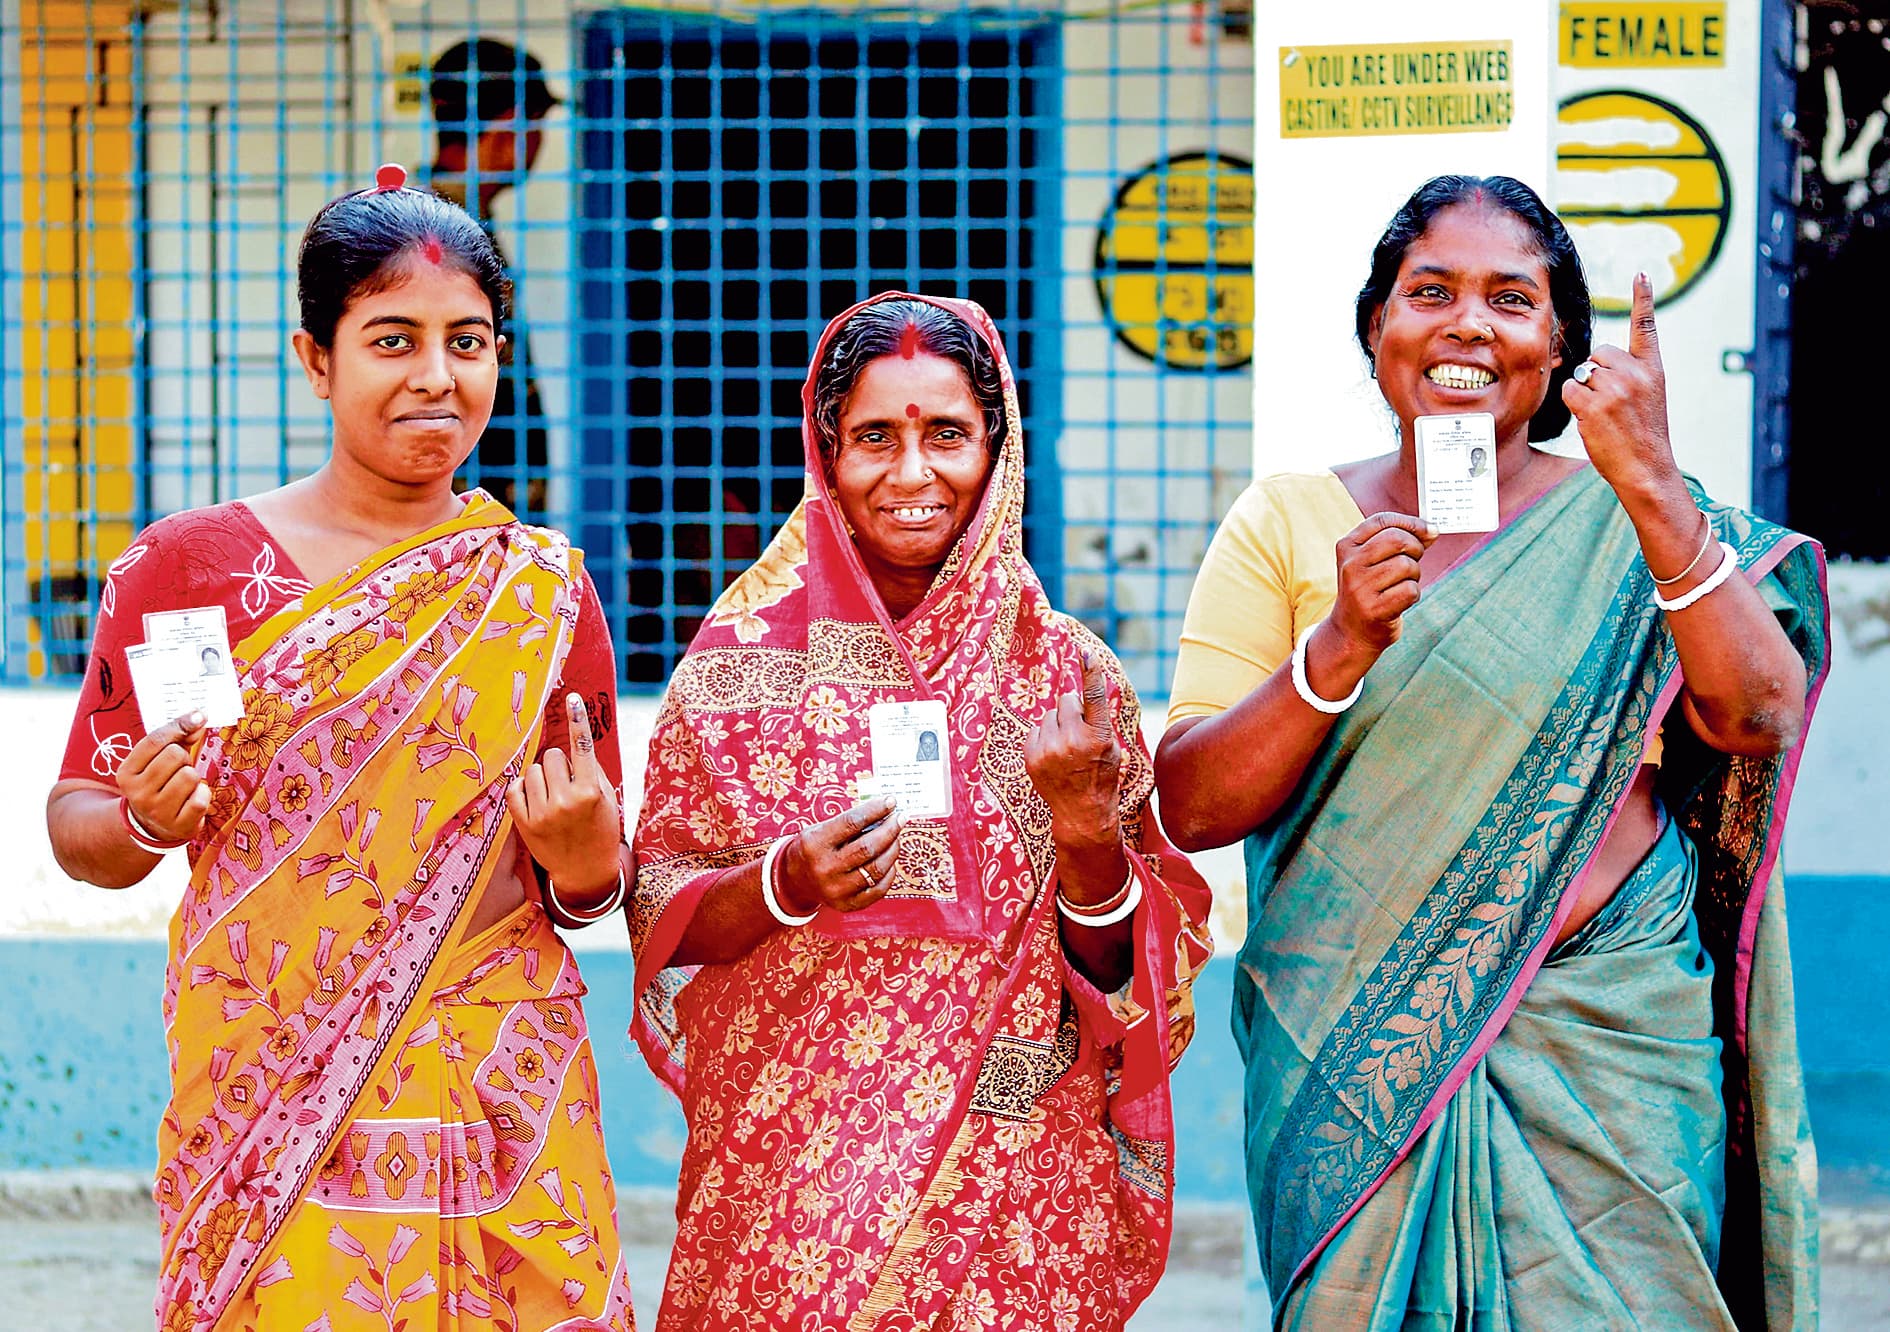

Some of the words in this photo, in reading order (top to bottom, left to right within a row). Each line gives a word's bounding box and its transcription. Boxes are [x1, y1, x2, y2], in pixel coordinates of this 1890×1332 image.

[1571, 16, 1721, 58] FEMALE
[1305, 55, 1344, 87] YOU
[1351, 54, 1387, 86] ARE
[1393, 52, 1459, 84] UNDER
[1465, 50, 1509, 82] WEB
[1362, 96, 1400, 128] CCTV
[1406, 92, 1511, 127] SURVEILLANCE
